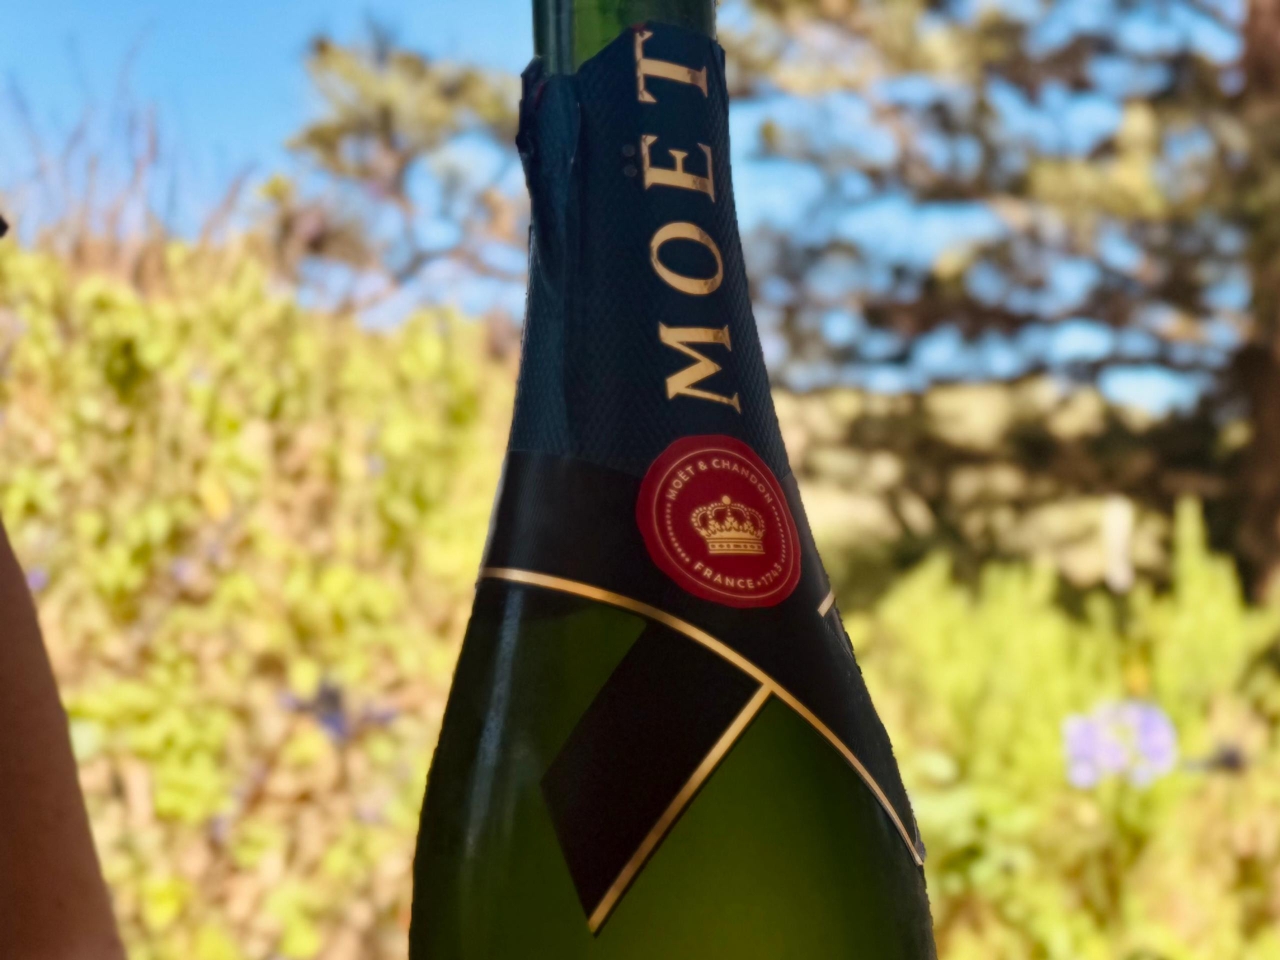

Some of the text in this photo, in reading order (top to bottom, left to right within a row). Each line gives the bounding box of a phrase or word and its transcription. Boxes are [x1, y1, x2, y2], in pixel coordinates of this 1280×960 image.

[666, 458, 773, 504] MOËT & CHANDON
[694, 562, 783, 589] FRANCE 1743
